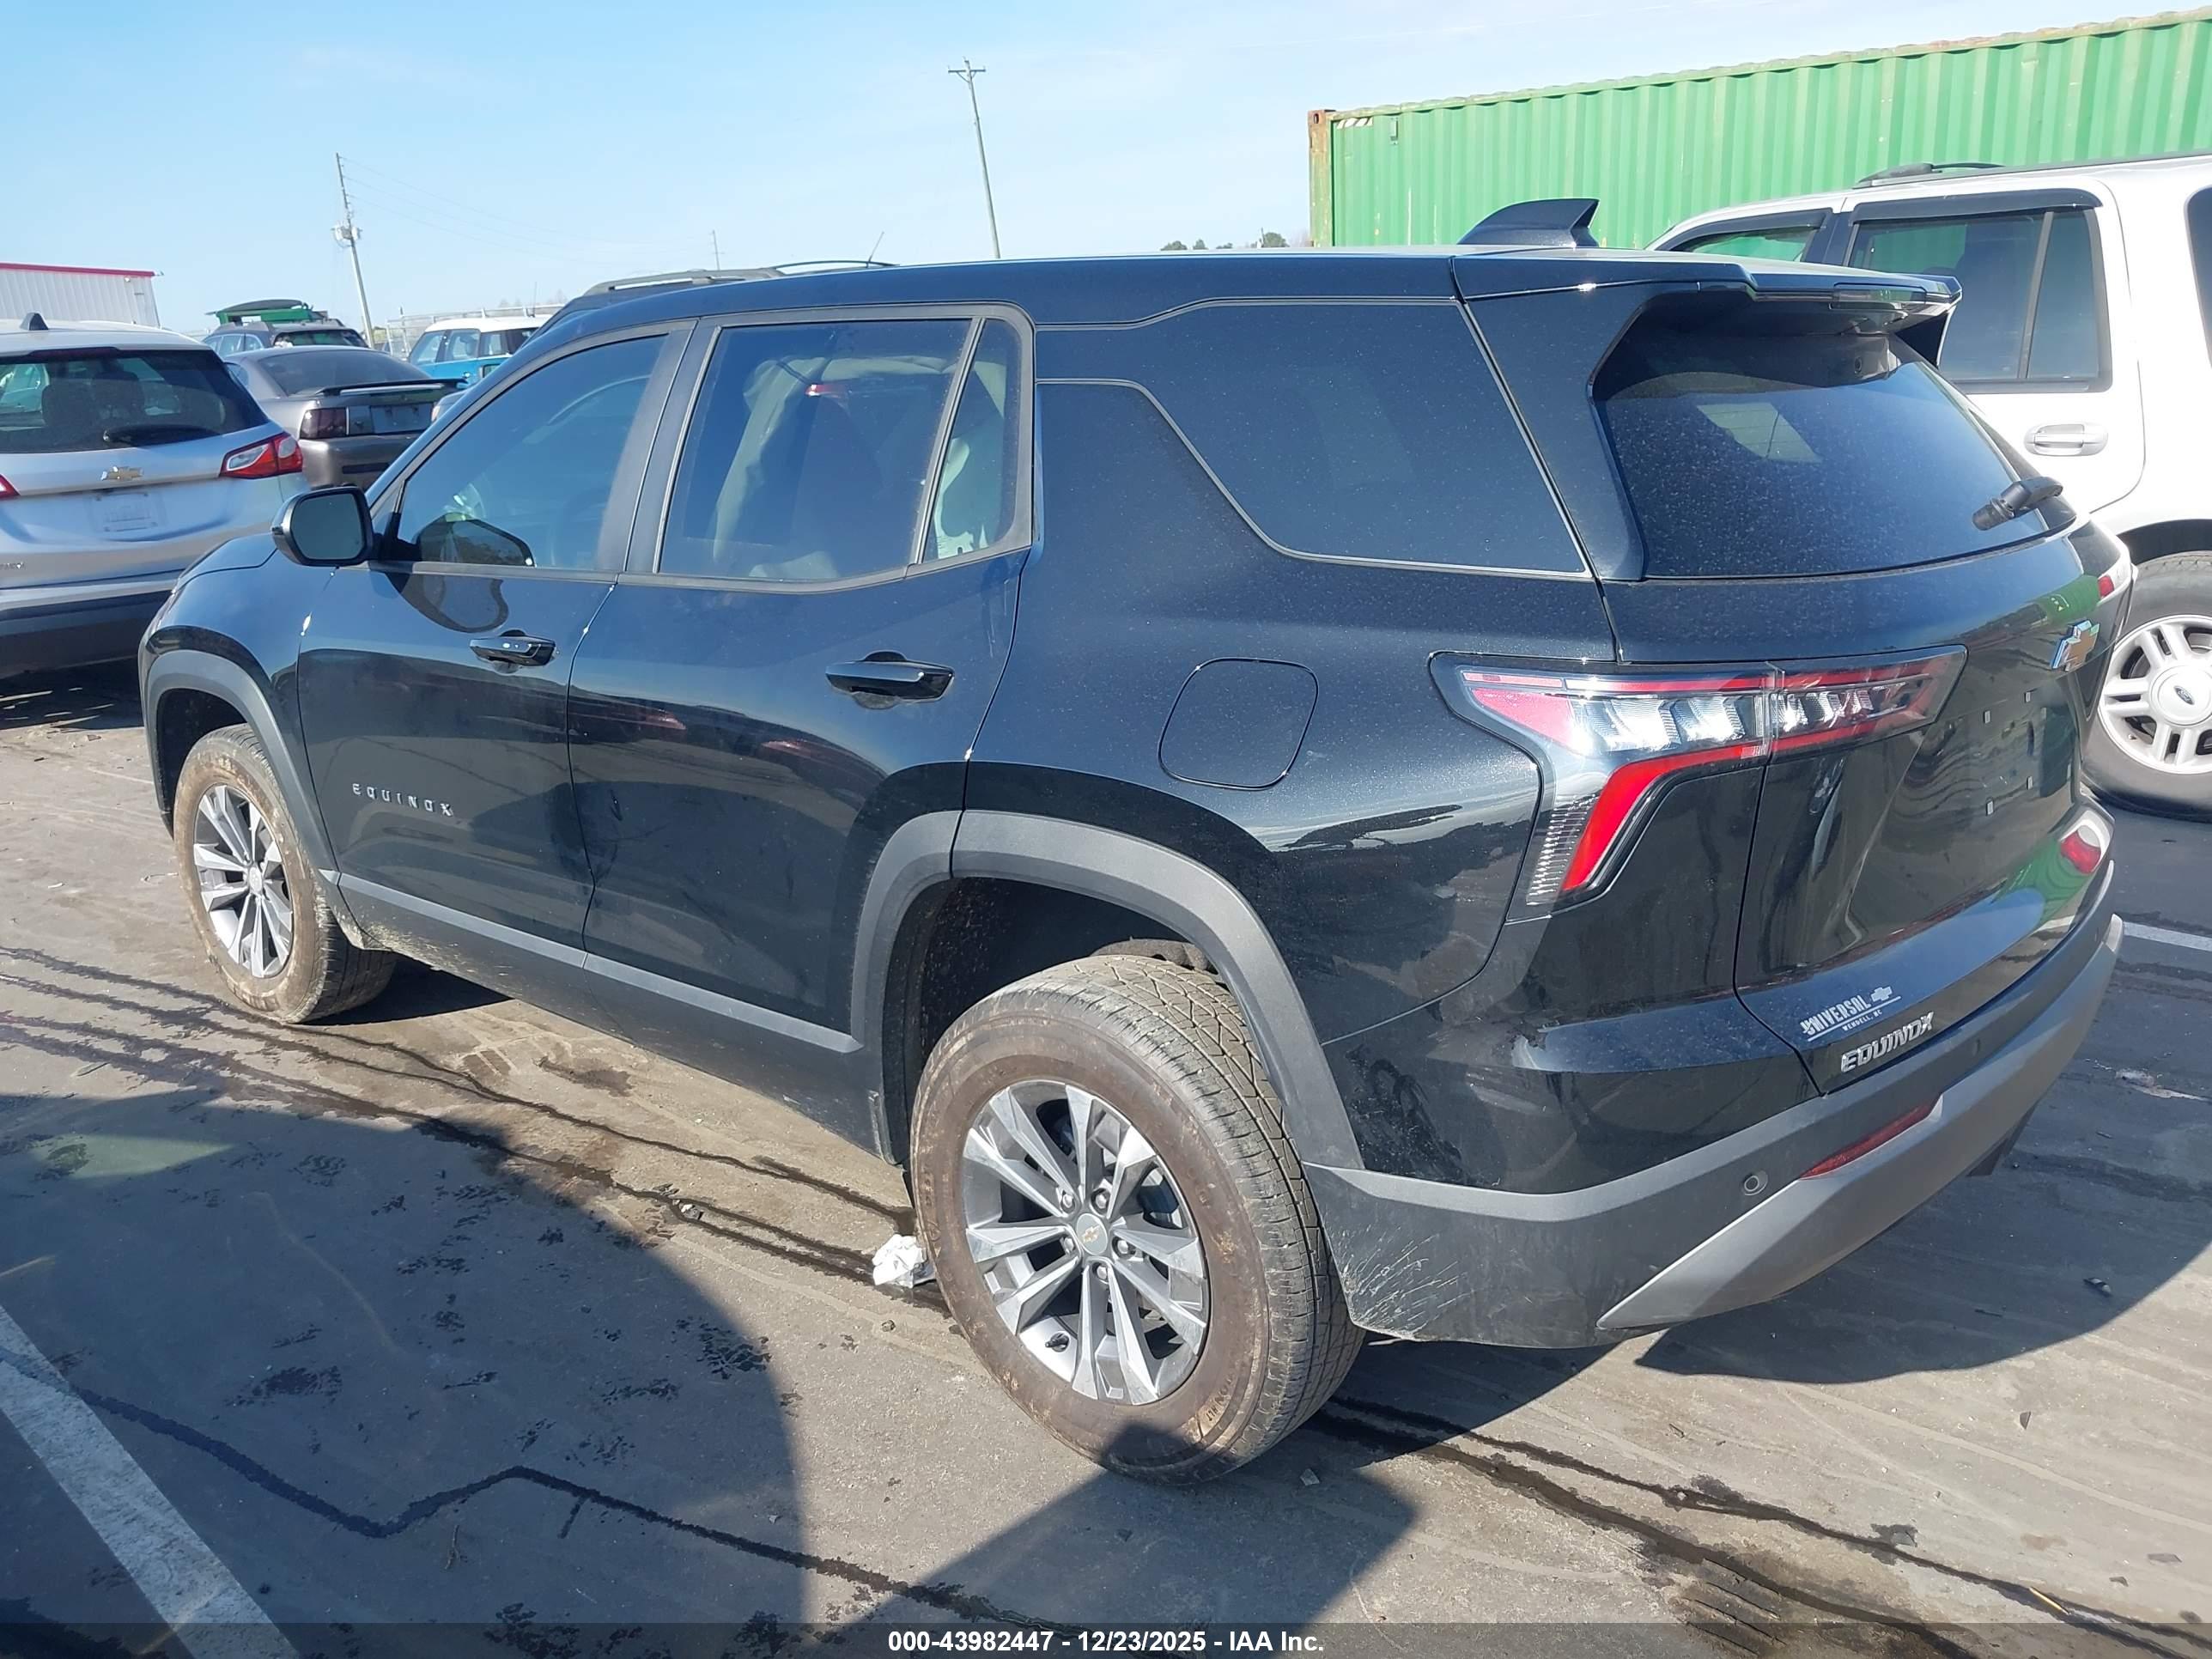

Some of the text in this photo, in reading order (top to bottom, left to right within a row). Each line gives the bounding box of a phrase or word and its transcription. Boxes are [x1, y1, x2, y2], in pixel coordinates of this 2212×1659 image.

[351, 782, 453, 817] EQUINOX
[1800, 994, 1872, 1036] UNIVERSAL
[1839, 1011, 1936, 1073] EQUINOX
